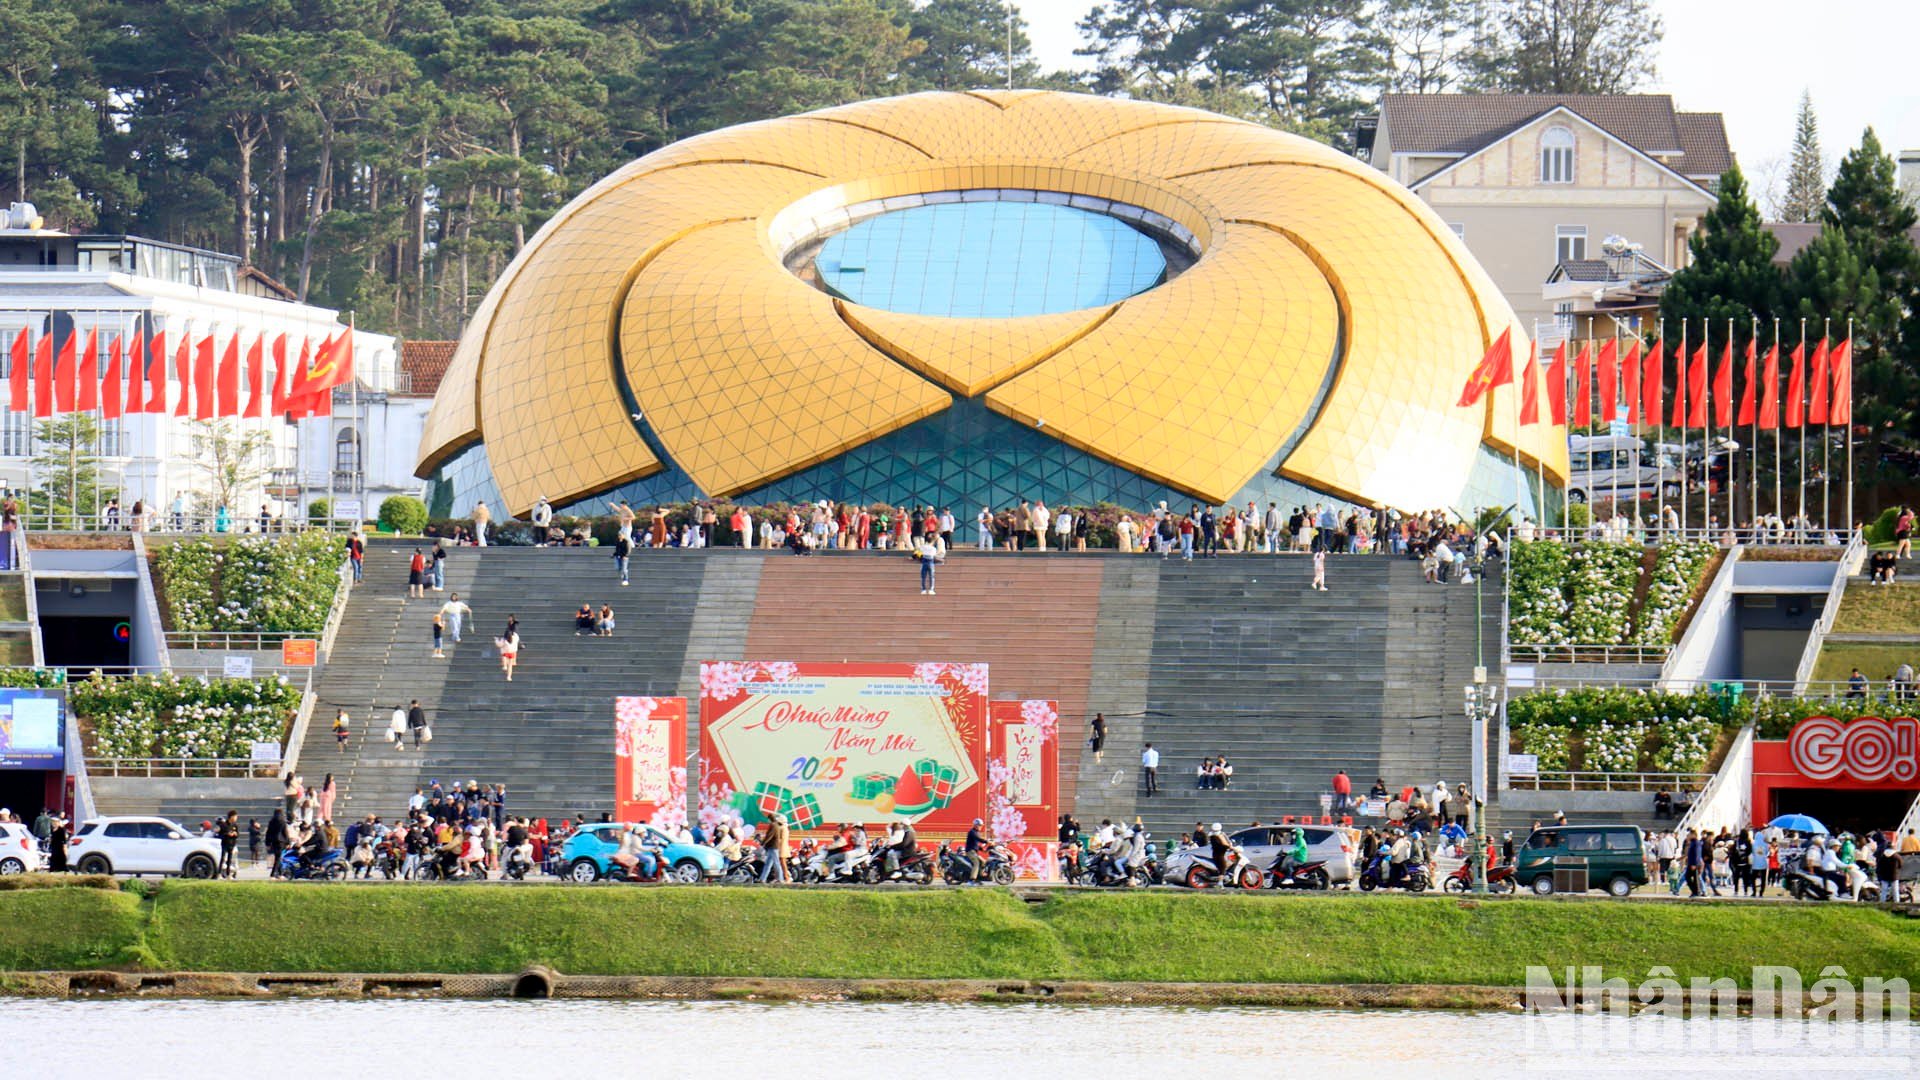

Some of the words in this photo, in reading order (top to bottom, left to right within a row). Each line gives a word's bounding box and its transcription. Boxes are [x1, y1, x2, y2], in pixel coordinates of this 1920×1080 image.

[741, 701, 835, 731] Chúc
[828, 705, 891, 729] Mừng
[825, 727, 881, 755] Năm
[881, 734, 926, 752] Mới
[1791, 718, 1917, 782] GO!
[786, 756, 848, 781] 2025
